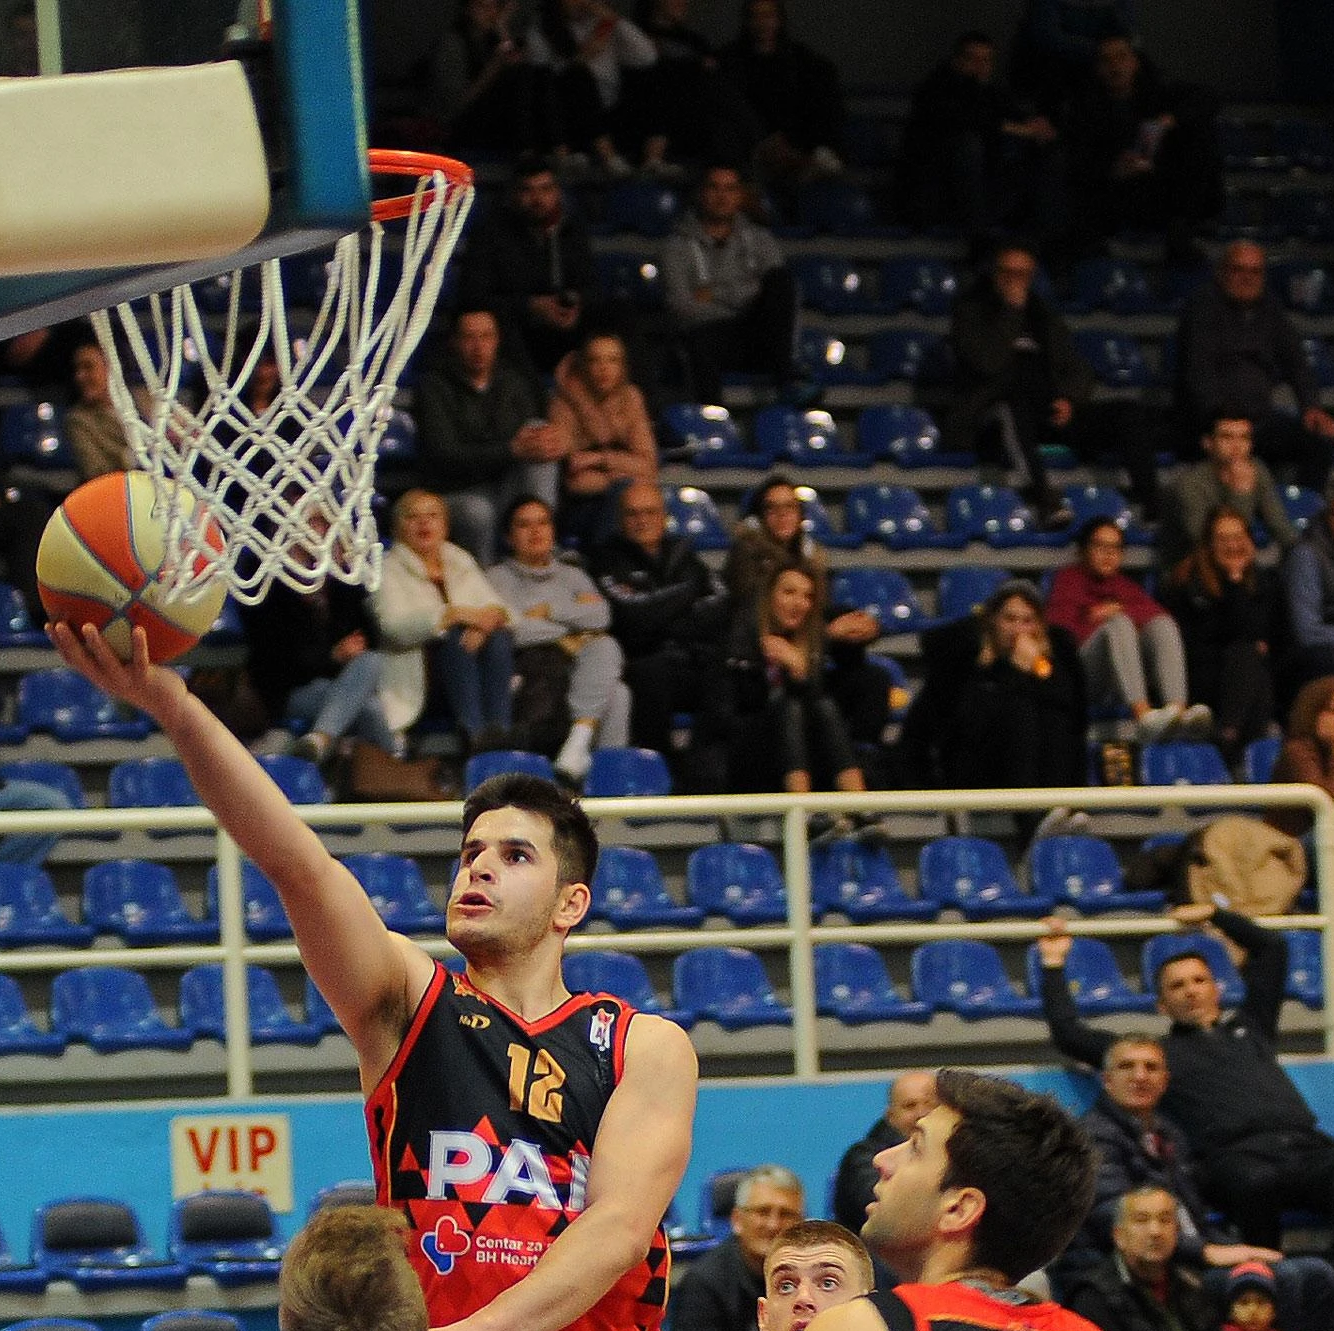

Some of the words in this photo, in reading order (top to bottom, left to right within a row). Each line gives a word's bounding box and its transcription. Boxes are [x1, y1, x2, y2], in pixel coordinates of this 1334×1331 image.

[507, 1042, 567, 1124] 12
[186, 1126, 277, 1174] VIP
[475, 1251, 498, 1264] BH
